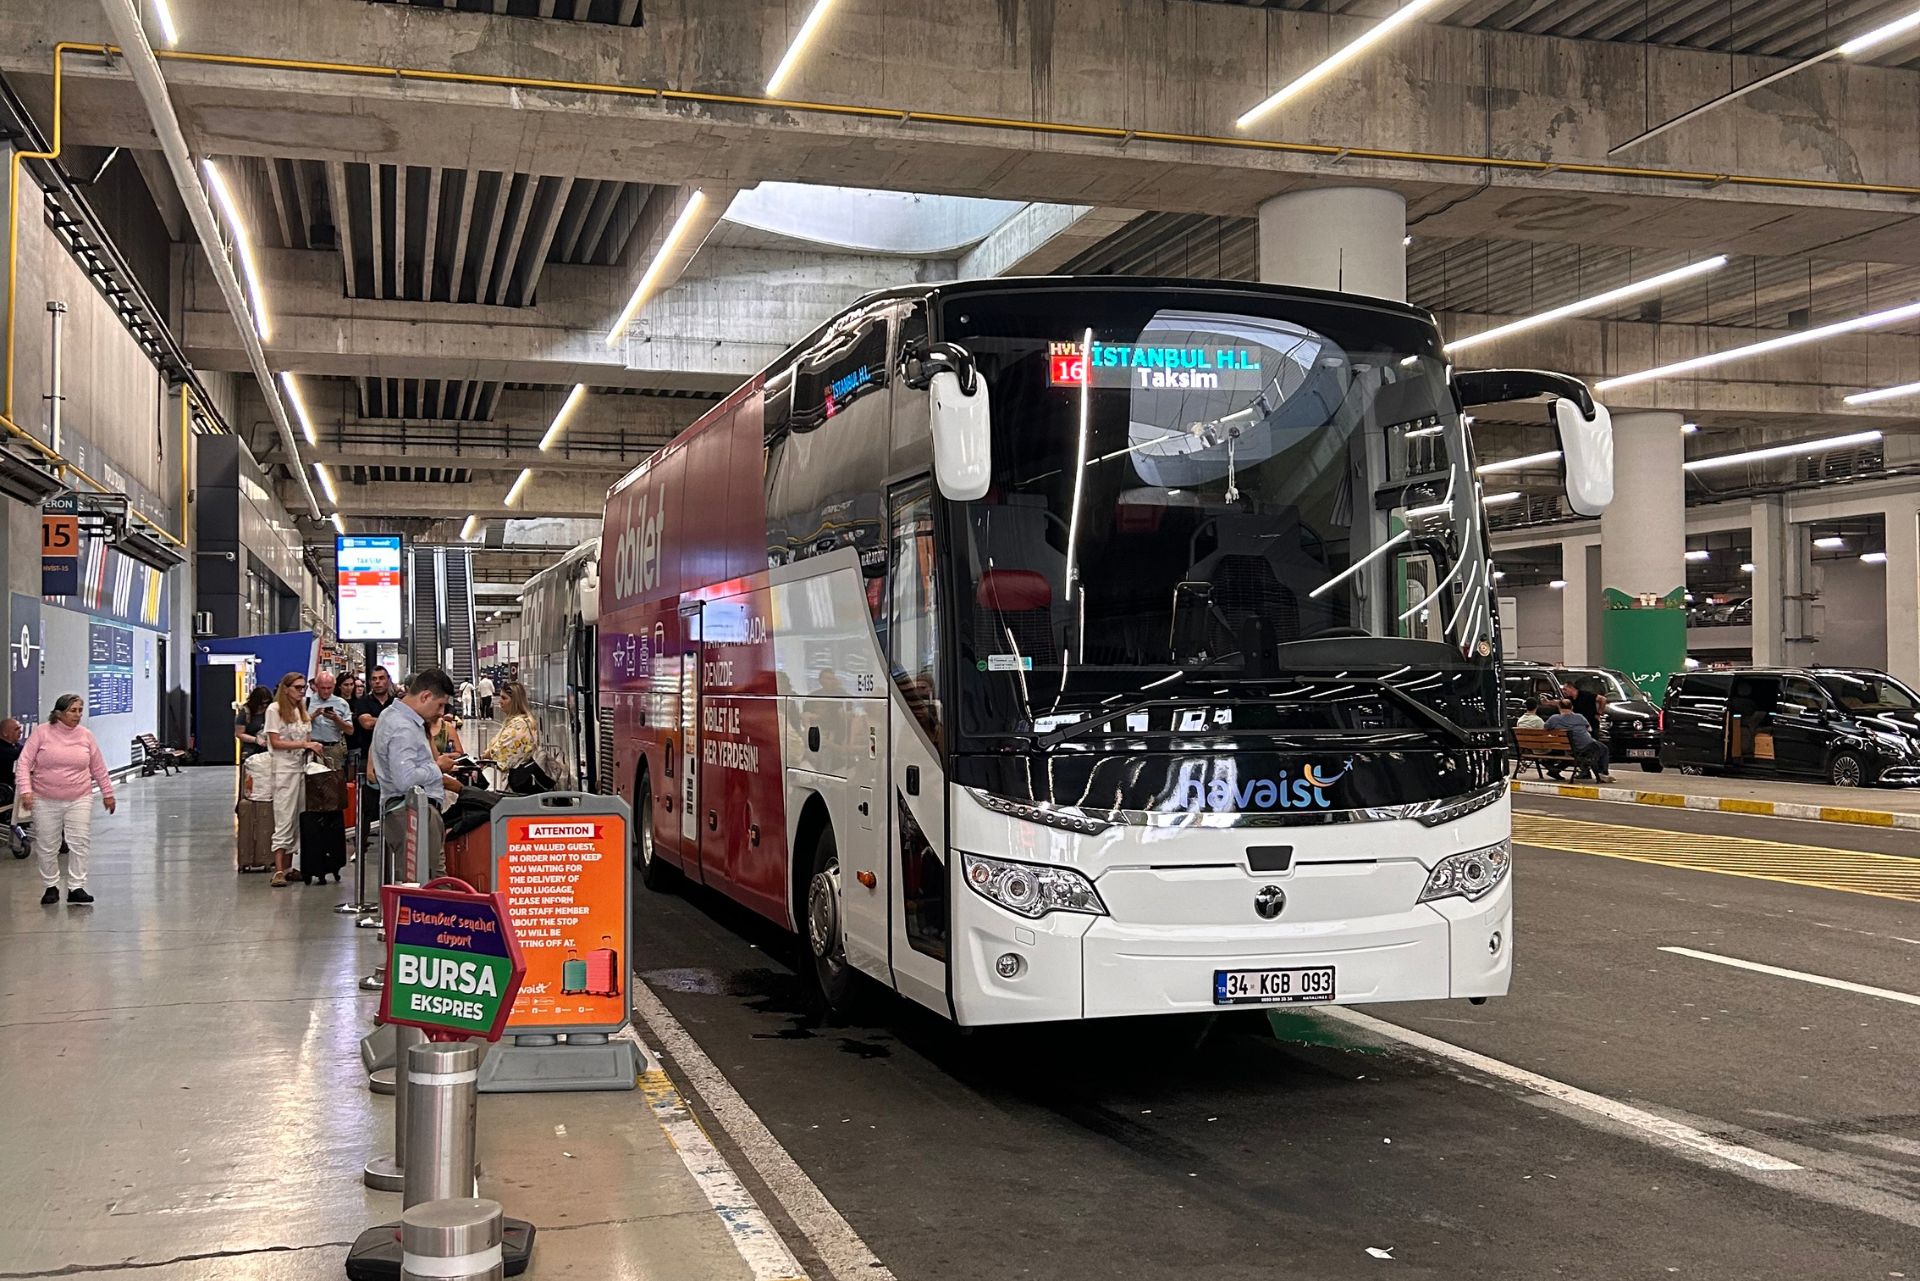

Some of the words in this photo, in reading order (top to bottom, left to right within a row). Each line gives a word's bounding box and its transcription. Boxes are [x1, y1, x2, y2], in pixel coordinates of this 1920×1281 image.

[1091, 341, 1211, 368] İSTANBUL
[1217, 350, 1260, 370] H.L.
[1059, 361, 1083, 380] 16
[1138, 367, 1218, 388] Taksim
[44, 500, 74, 508] ERON
[42, 523, 71, 547] 15
[615, 482, 665, 600] obilet
[704, 654, 733, 687] DENİZDE
[1632, 671, 1661, 685] مرحبا
[704, 699, 727, 732] OBİLET
[703, 738, 717, 763] HER
[718, 736, 759, 773] YERDESİN!
[1179, 763, 1331, 809] havaist
[534, 826, 590, 836] ATTENTION
[509, 843, 533, 852] DEAR
[534, 843, 566, 852] VALUED
[567, 843, 595, 852] GUEST,
[509, 855, 519, 863] IN
[520, 855, 549, 863] ORDER
[549, 854, 567, 862] NOT
[569, 854, 580, 862] TO
[581, 853, 602, 861] KEEP
[509, 865, 527, 874] YOU
[528, 865, 564, 873] WAITING
[566, 864, 583, 872] FOR
[509, 876, 525, 884] THE
[568, 875, 580, 883] OF
[509, 887, 533, 895] YOUR
[533, 886, 575, 895] LUGGAGE,
[509, 897, 540, 906] PLEASE
[542, 896, 574, 904] INFORM
[509, 908, 527, 916] OUR
[528, 907, 554, 915] STAFF
[555, 907, 590, 915] MEMBER
[412, 909, 457, 928] istanbul
[459, 916, 496, 934] seyahat
[539, 918, 556, 926] THE
[557, 918, 579, 926] STOP
[437, 931, 472, 948] airport
[515, 930, 527, 938] OU
[528, 929, 548, 937] WILL
[518, 940, 545, 948] TTING
[563, 939, 576, 947] AT.
[398, 953, 498, 998] BURSA
[1228, 975, 1249, 996] 34
[1260, 974, 1291, 995] KGB
[1301, 971, 1331, 992] 093
[410, 993, 484, 1020] EKSPRES
